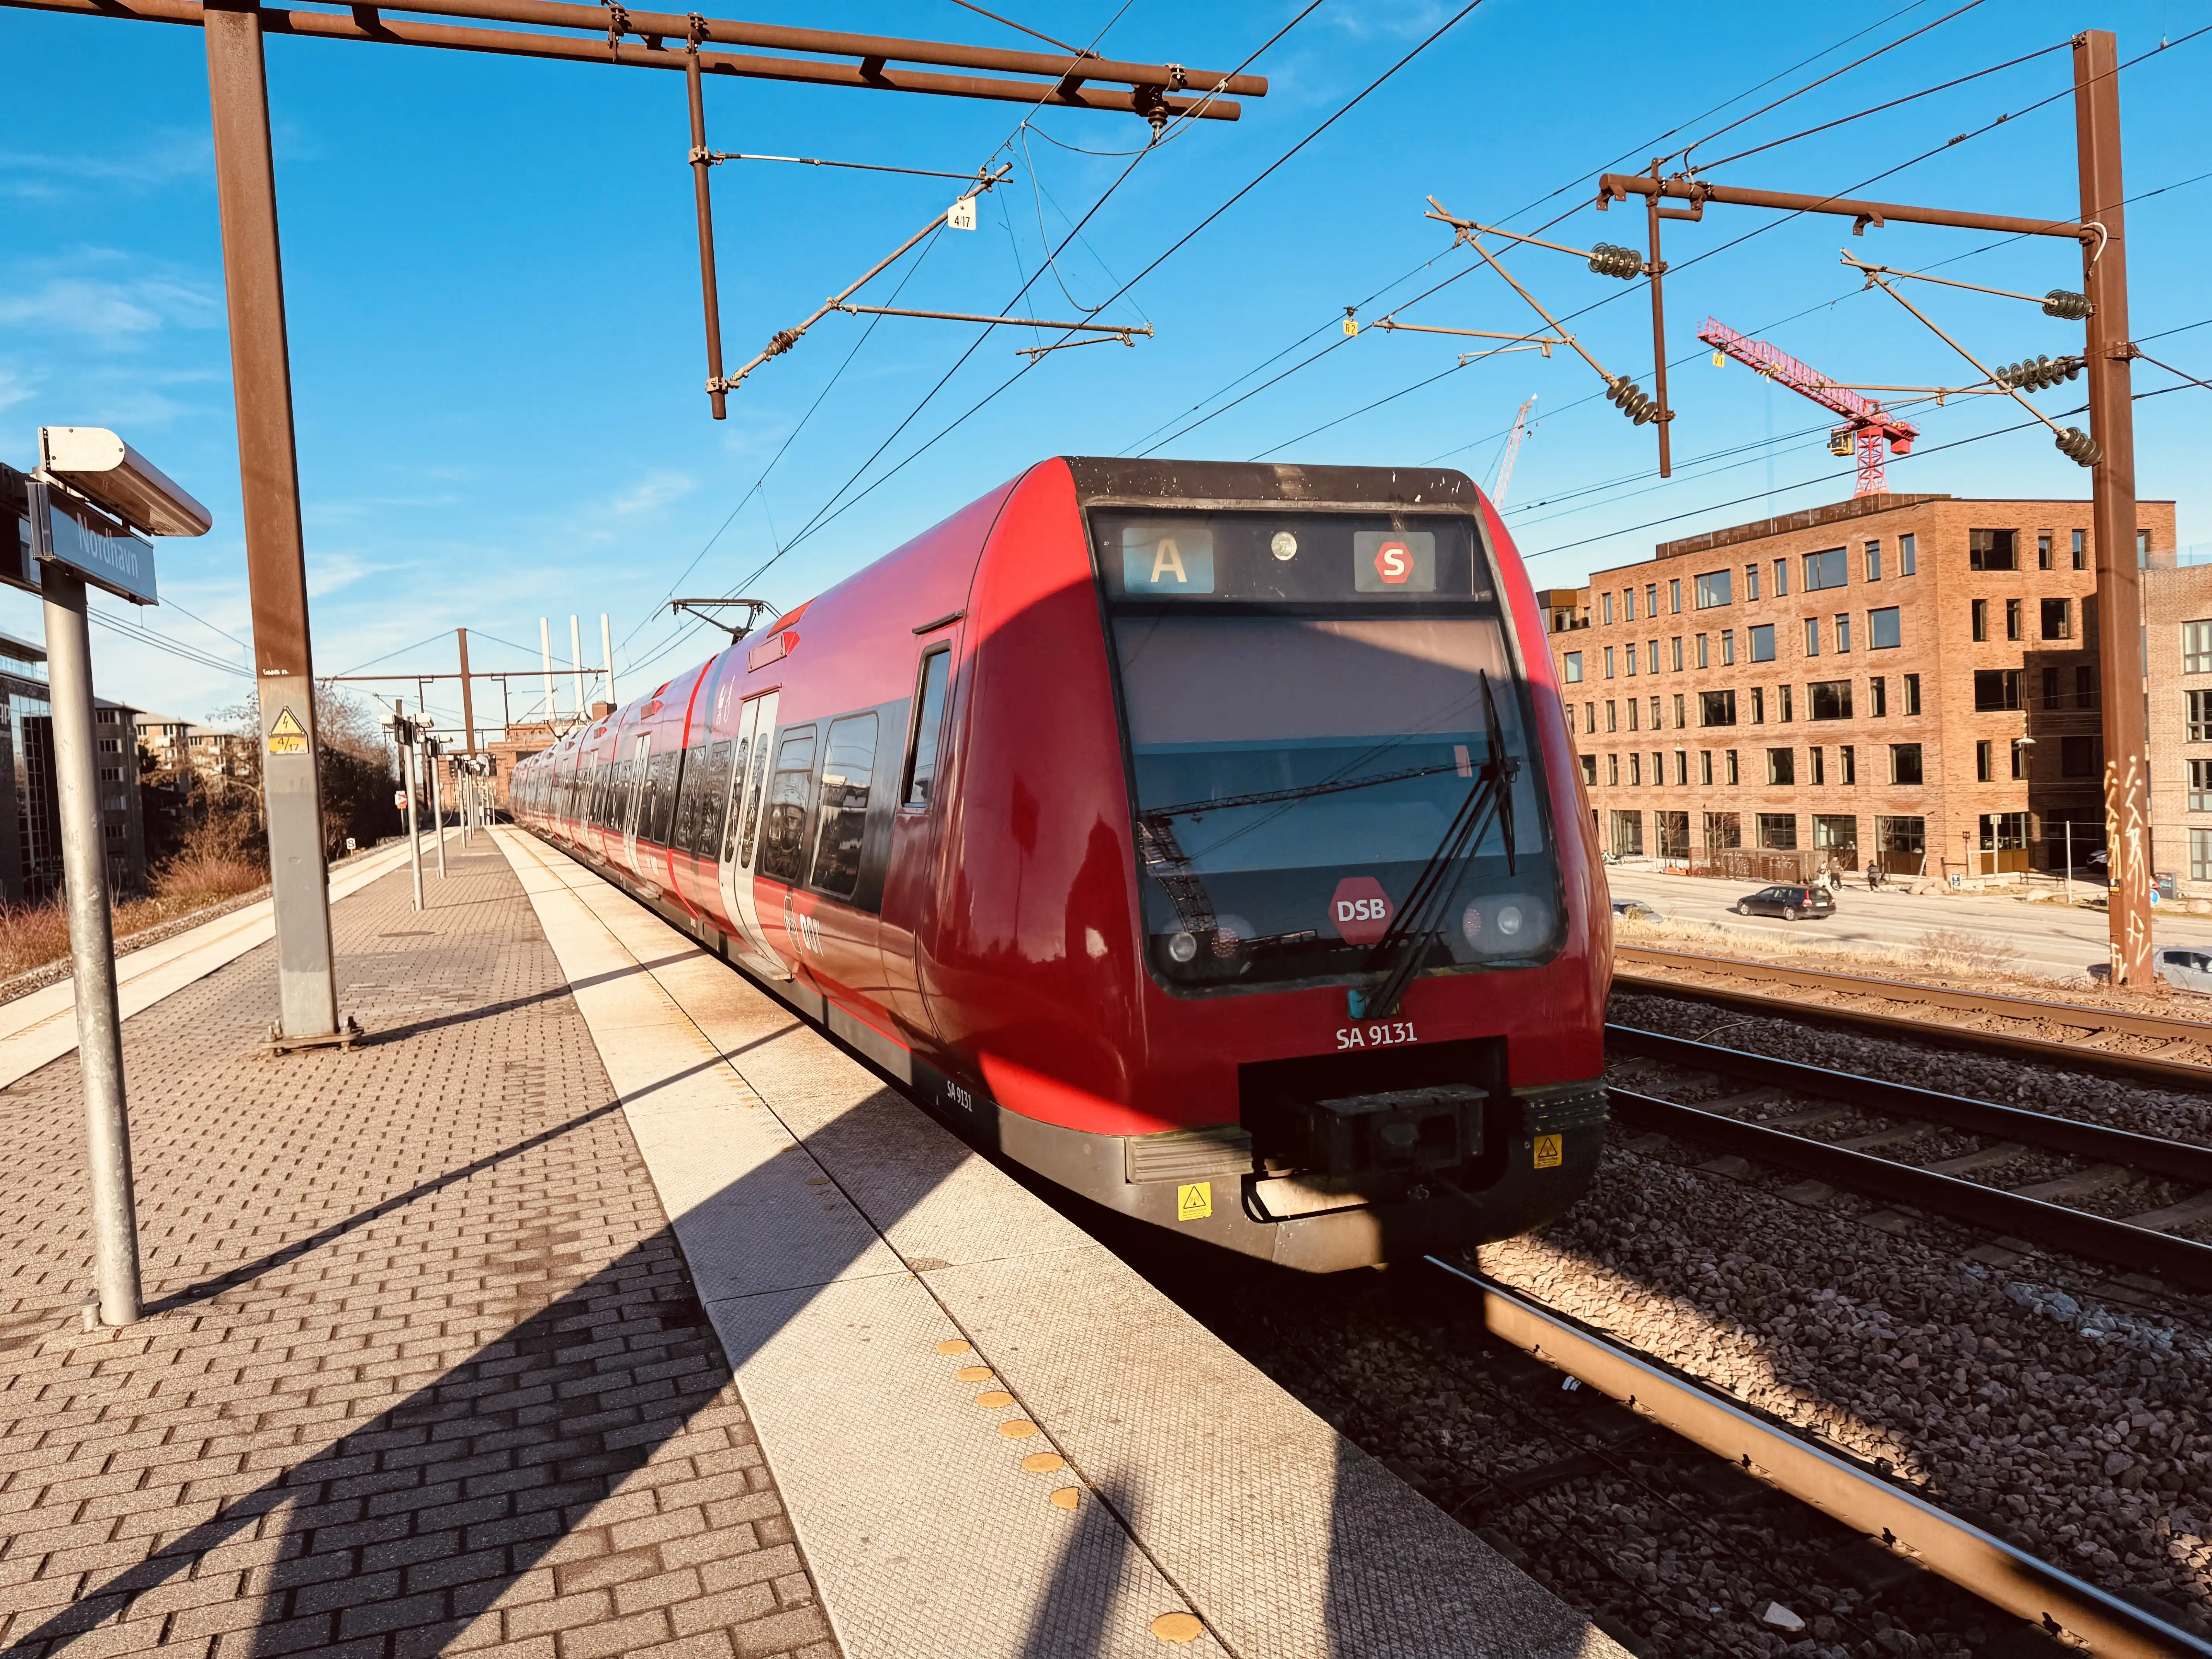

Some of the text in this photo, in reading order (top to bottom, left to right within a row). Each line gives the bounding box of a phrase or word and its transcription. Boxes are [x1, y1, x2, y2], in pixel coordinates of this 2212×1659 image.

[954, 215, 970, 228] 4/17
[77, 512, 139, 579] Nordhavn
[1151, 539, 1187, 582] A
[1383, 549, 1405, 576] S
[278, 737, 299, 752] 4/17
[1337, 898, 1386, 922] DSB
[1336, 1022, 1418, 1049] SA 9131
[947, 1080, 972, 1112] SA 9131
